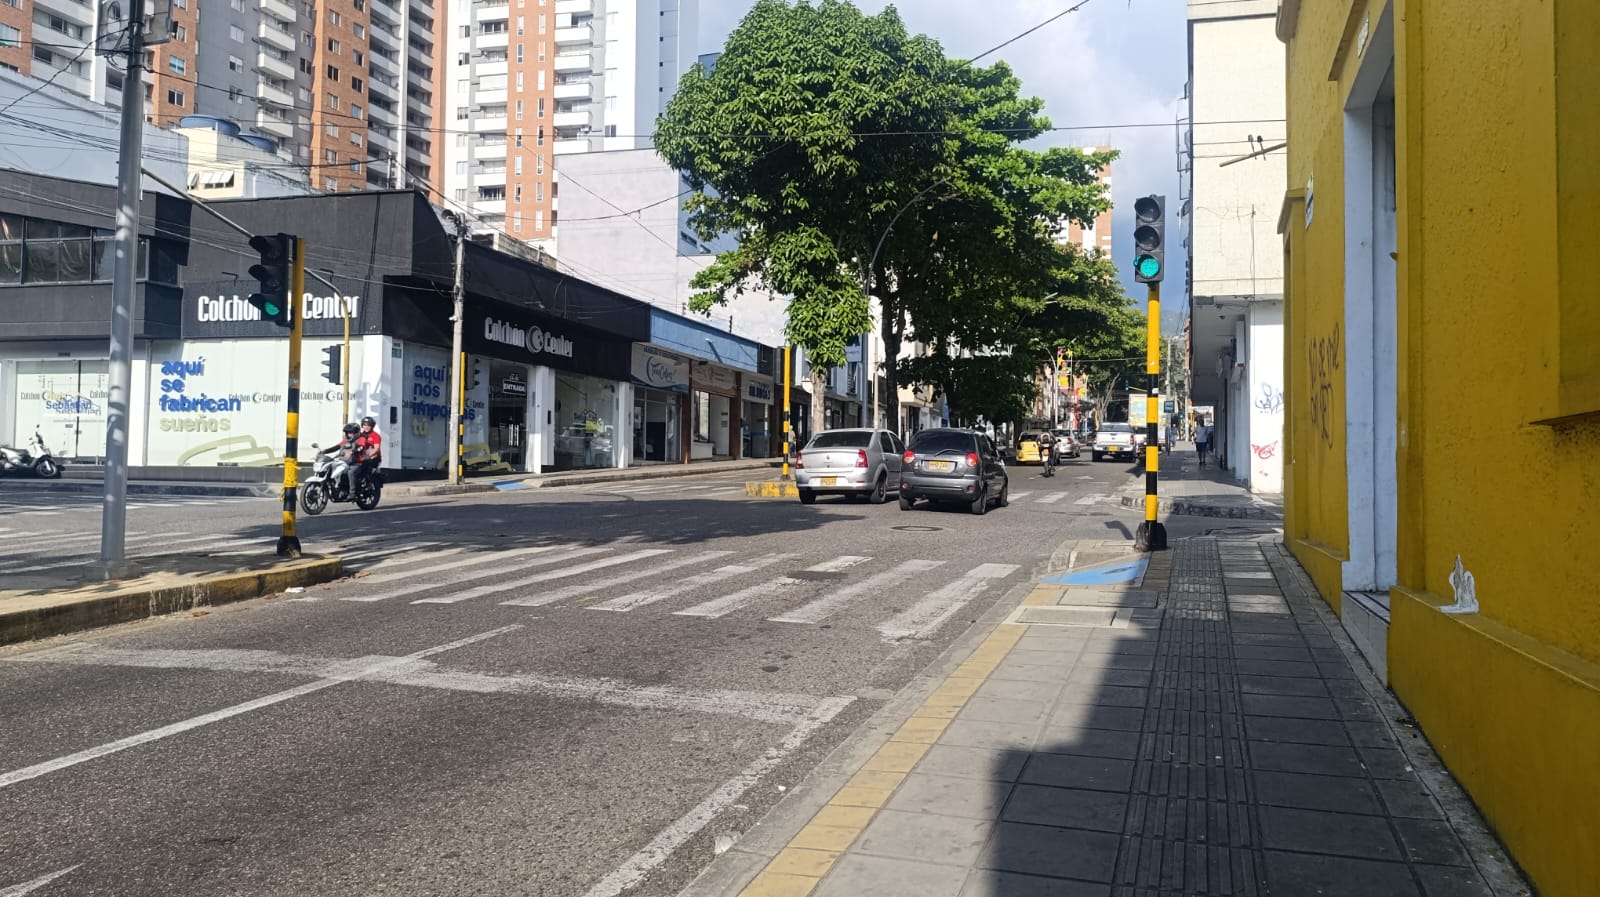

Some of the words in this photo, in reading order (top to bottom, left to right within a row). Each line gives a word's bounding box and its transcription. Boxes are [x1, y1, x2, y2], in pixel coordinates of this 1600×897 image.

[302, 293, 360, 319] Center
[544, 332, 574, 358] Center
[161, 356, 206, 380] aquí
[89, 390, 109, 400] Colcho
[160, 379, 185, 393] se
[413, 382, 440, 398] nos
[159, 393, 241, 412] fabrican
[412, 396, 476, 421] impoas
[160, 413, 231, 432] sueños
